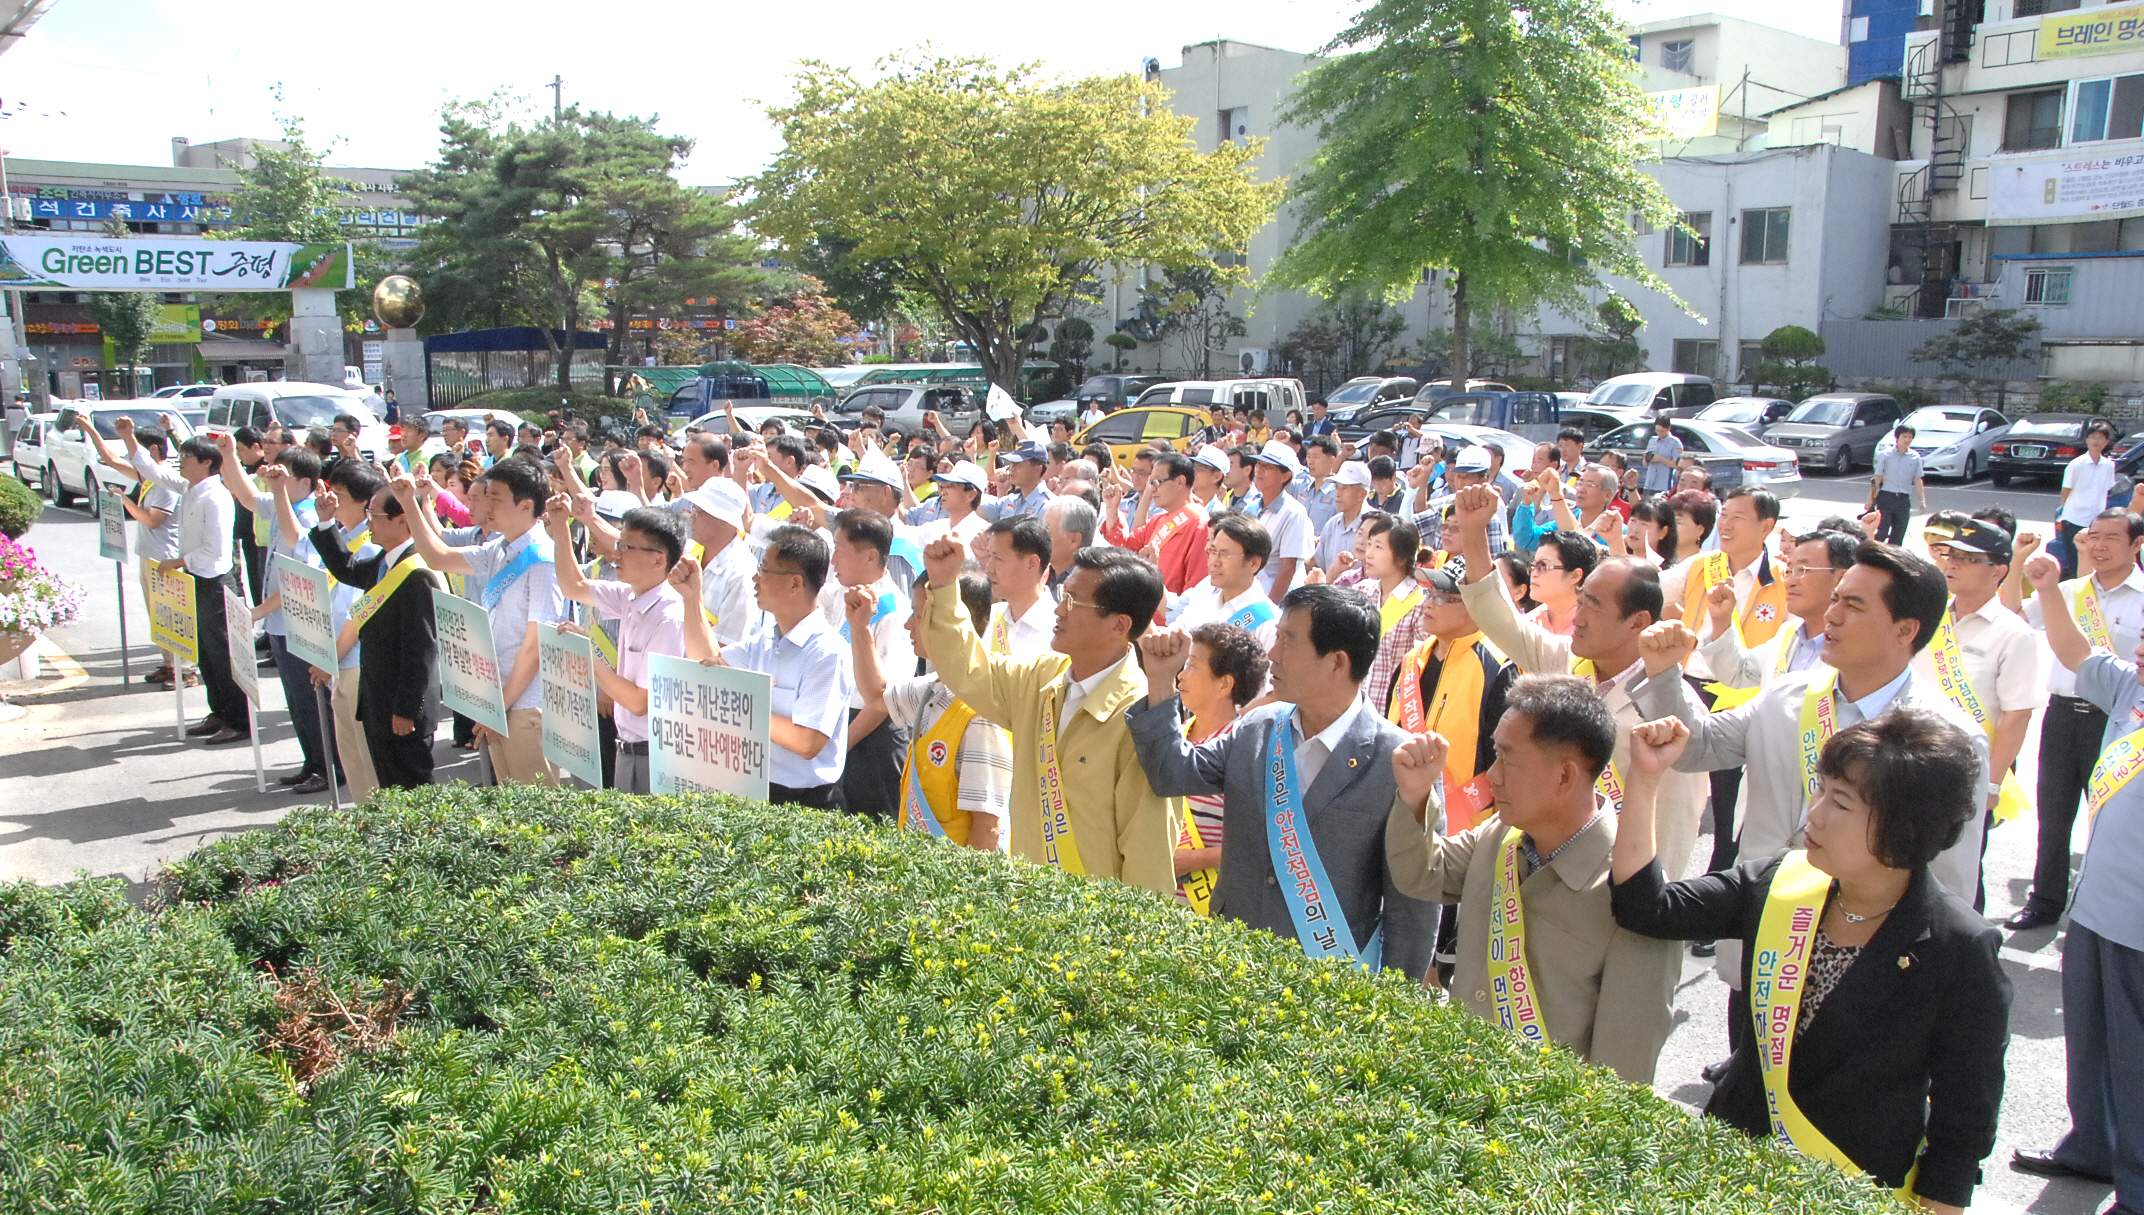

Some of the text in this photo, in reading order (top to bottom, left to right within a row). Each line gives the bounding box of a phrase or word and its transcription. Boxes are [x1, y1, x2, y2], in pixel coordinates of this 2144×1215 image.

[2056, 21, 2113, 46] 브레인
[41, 247, 276, 279] Green BEST 증평
[71, 245, 122, 254] 저탄소 녹색도시
[176, 578, 187, 607] 명절
[283, 594, 292, 618] 우리
[291, 598, 304, 624] 모두의
[2084, 594, 2103, 632] 즐거운
[436, 605, 467, 642] 안전점검은
[996, 622, 1008, 654] 즐거
[439, 638, 499, 689] 가장 확실한 행복보험
[1934, 649, 1953, 691] 행복의
[1941, 623, 1955, 651] 가스
[1949, 655, 1987, 724] 안전점검은
[567, 689, 593, 731] 가족안전
[652, 674, 753, 731] 함께하는 재난훈련이
[1404, 698, 1420, 730] 작은
[1817, 695, 1833, 741] 즐거
[652, 716, 764, 779] 예고없는 재난예방한다
[2112, 746, 2144, 784] 거운
[1046, 743, 1068, 834] 고향길은
[1272, 739, 1288, 806] 4일은
[1040, 775, 1059, 865] 먼저입니
[1275, 808, 1328, 924] 안전점검의
[1503, 842, 1519, 925] 즐거운
[1312, 925, 1338, 951] 날
[1491, 880, 1515, 1031] 안전이 먼저
[1770, 906, 1815, 1067] 즐거운 명절
[1754, 949, 1778, 1073] 안전하게
